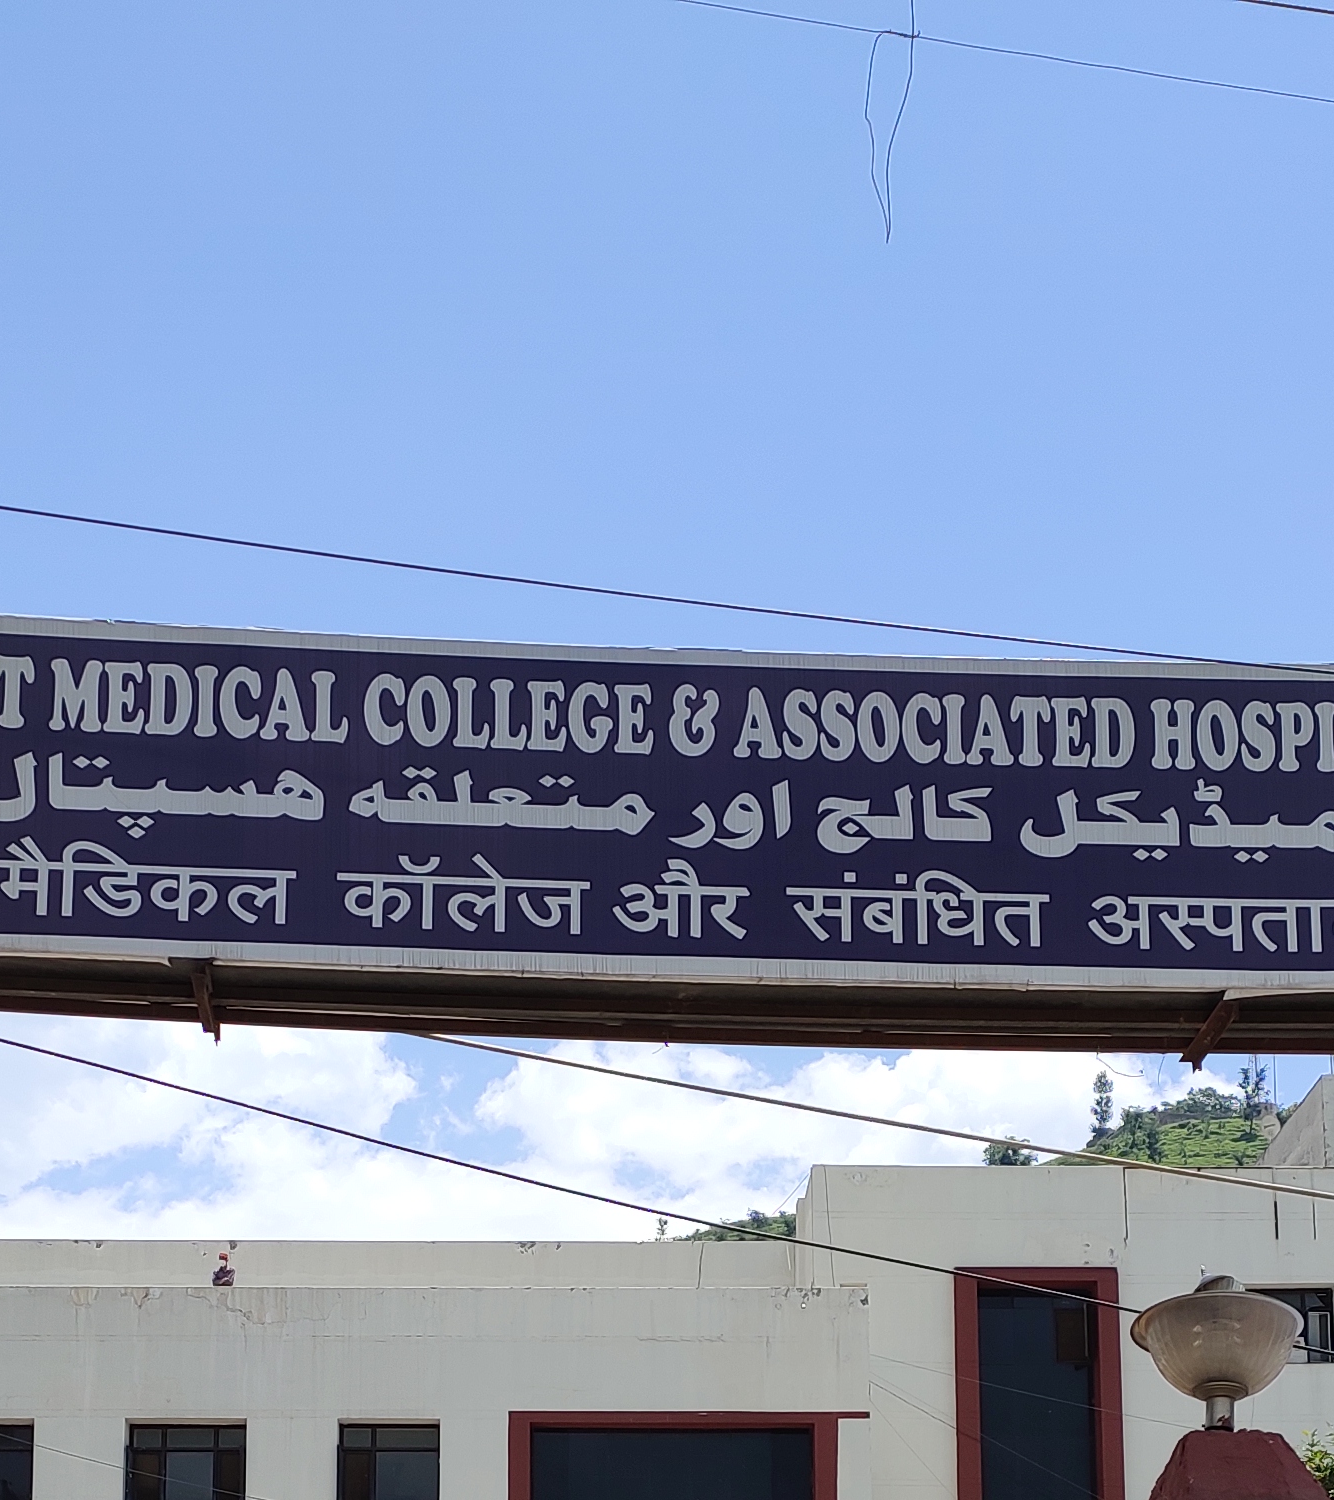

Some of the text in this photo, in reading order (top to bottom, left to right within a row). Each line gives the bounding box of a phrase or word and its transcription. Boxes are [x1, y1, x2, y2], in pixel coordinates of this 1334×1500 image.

[48, 658, 349, 744] MEDICAL
[363, 673, 654, 755] COLLEGE
[668, 683, 720, 757] &
[733, 686, 1135, 770] ASSOCIATED
[668, 779, 791, 850] اور
[817, 784, 993, 854] کالج
[336, 853, 591, 935] कॉलेज
[612, 858, 751, 940] और
[785, 870, 1050, 947] संबंधित
